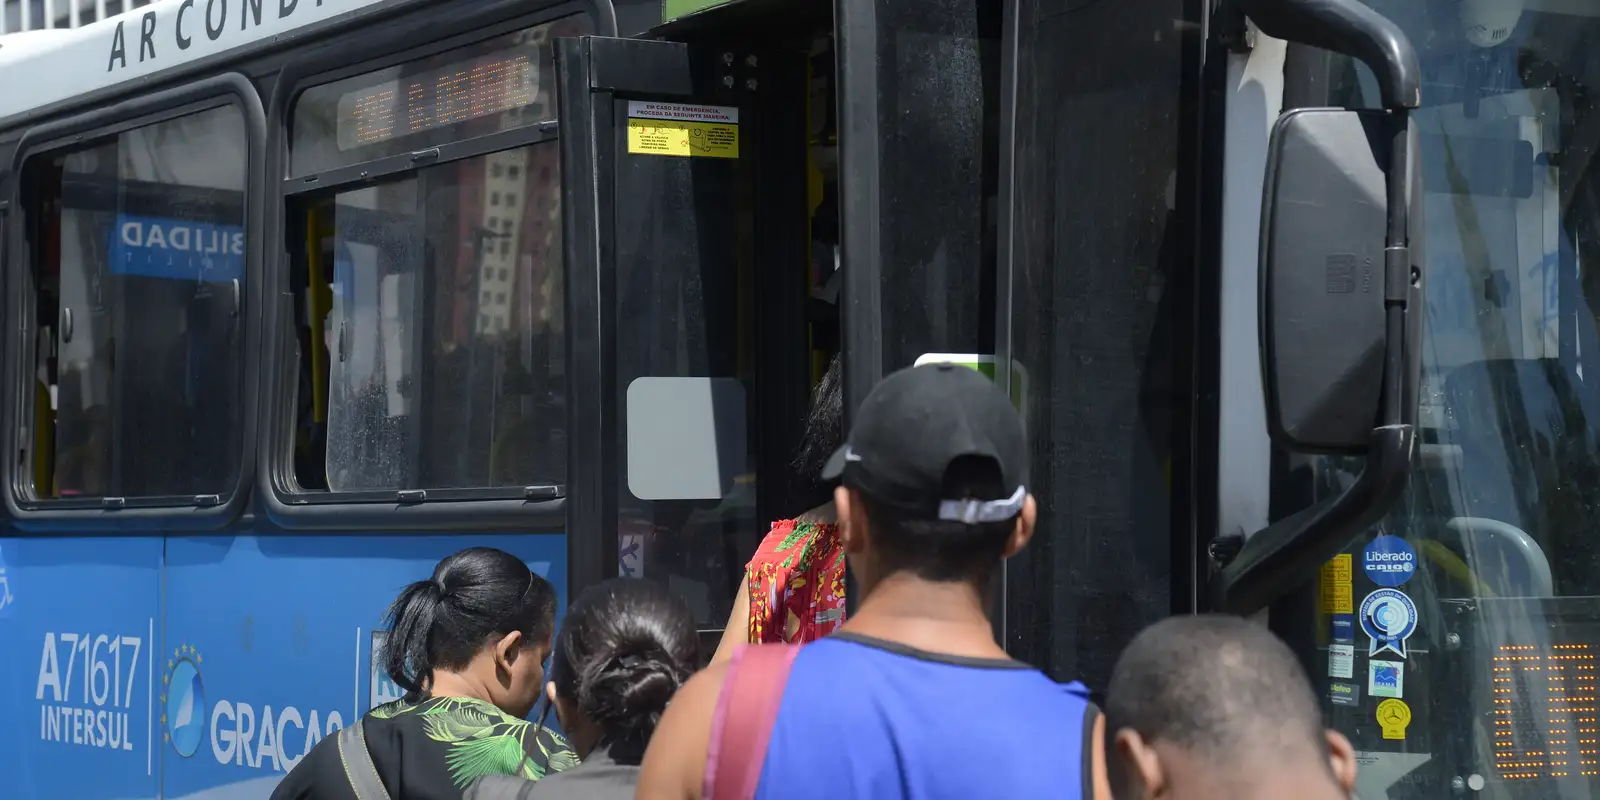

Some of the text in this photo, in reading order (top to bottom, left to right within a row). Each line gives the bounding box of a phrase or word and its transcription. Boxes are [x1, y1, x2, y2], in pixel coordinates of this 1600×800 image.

[107, 11, 157, 72] AR
[1366, 551, 1413, 561] Liberado
[36, 632, 141, 708] A71617
[41, 704, 133, 751] INTERSUL
